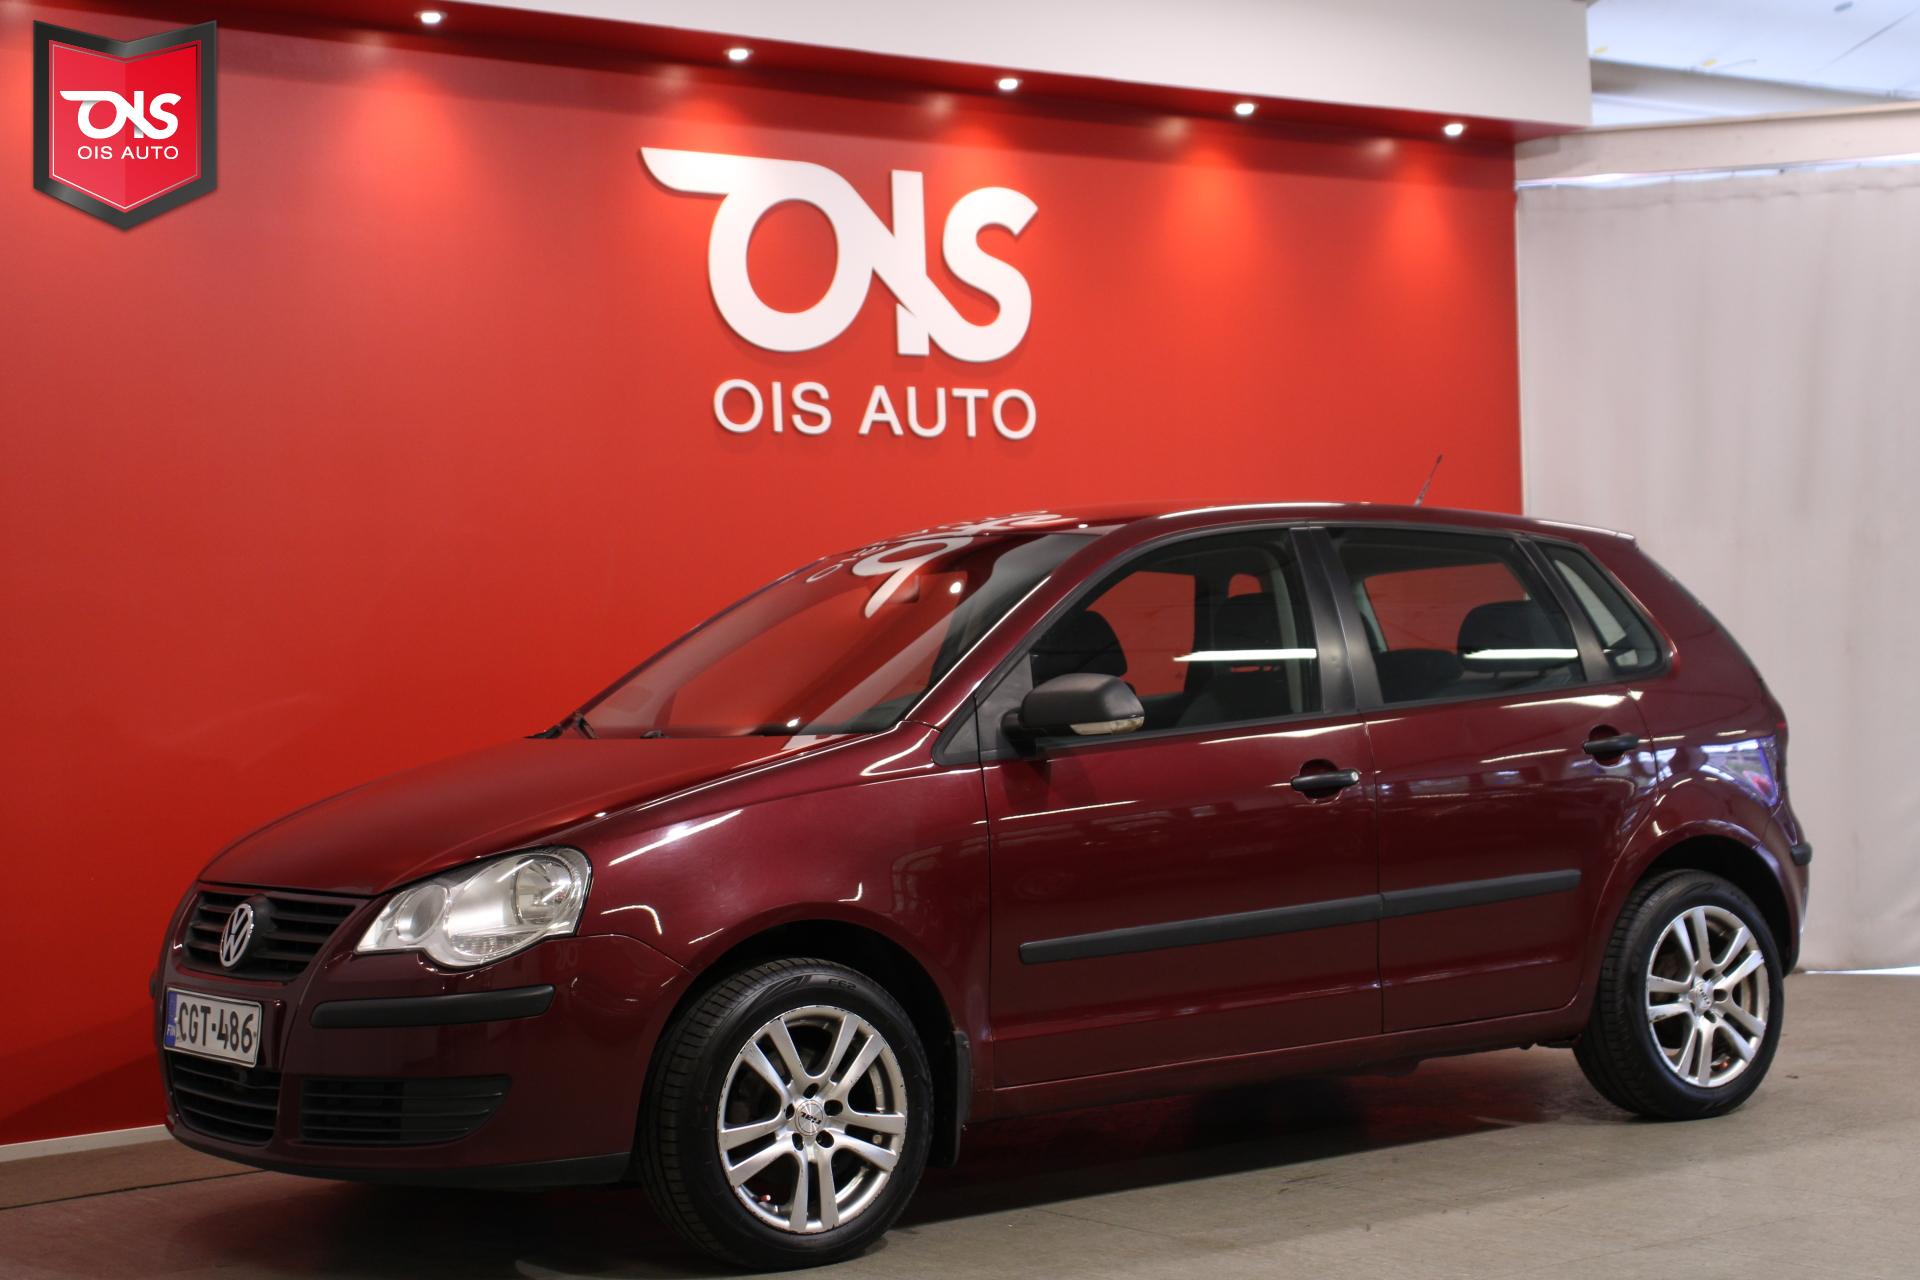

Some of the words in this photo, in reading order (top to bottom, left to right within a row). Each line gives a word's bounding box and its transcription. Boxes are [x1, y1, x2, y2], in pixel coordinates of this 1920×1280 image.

[640, 147, 1039, 362] OIS
[713, 378, 832, 435] OIS
[858, 385, 1037, 440] AUTO
[178, 1002, 254, 1053] CGT-486
